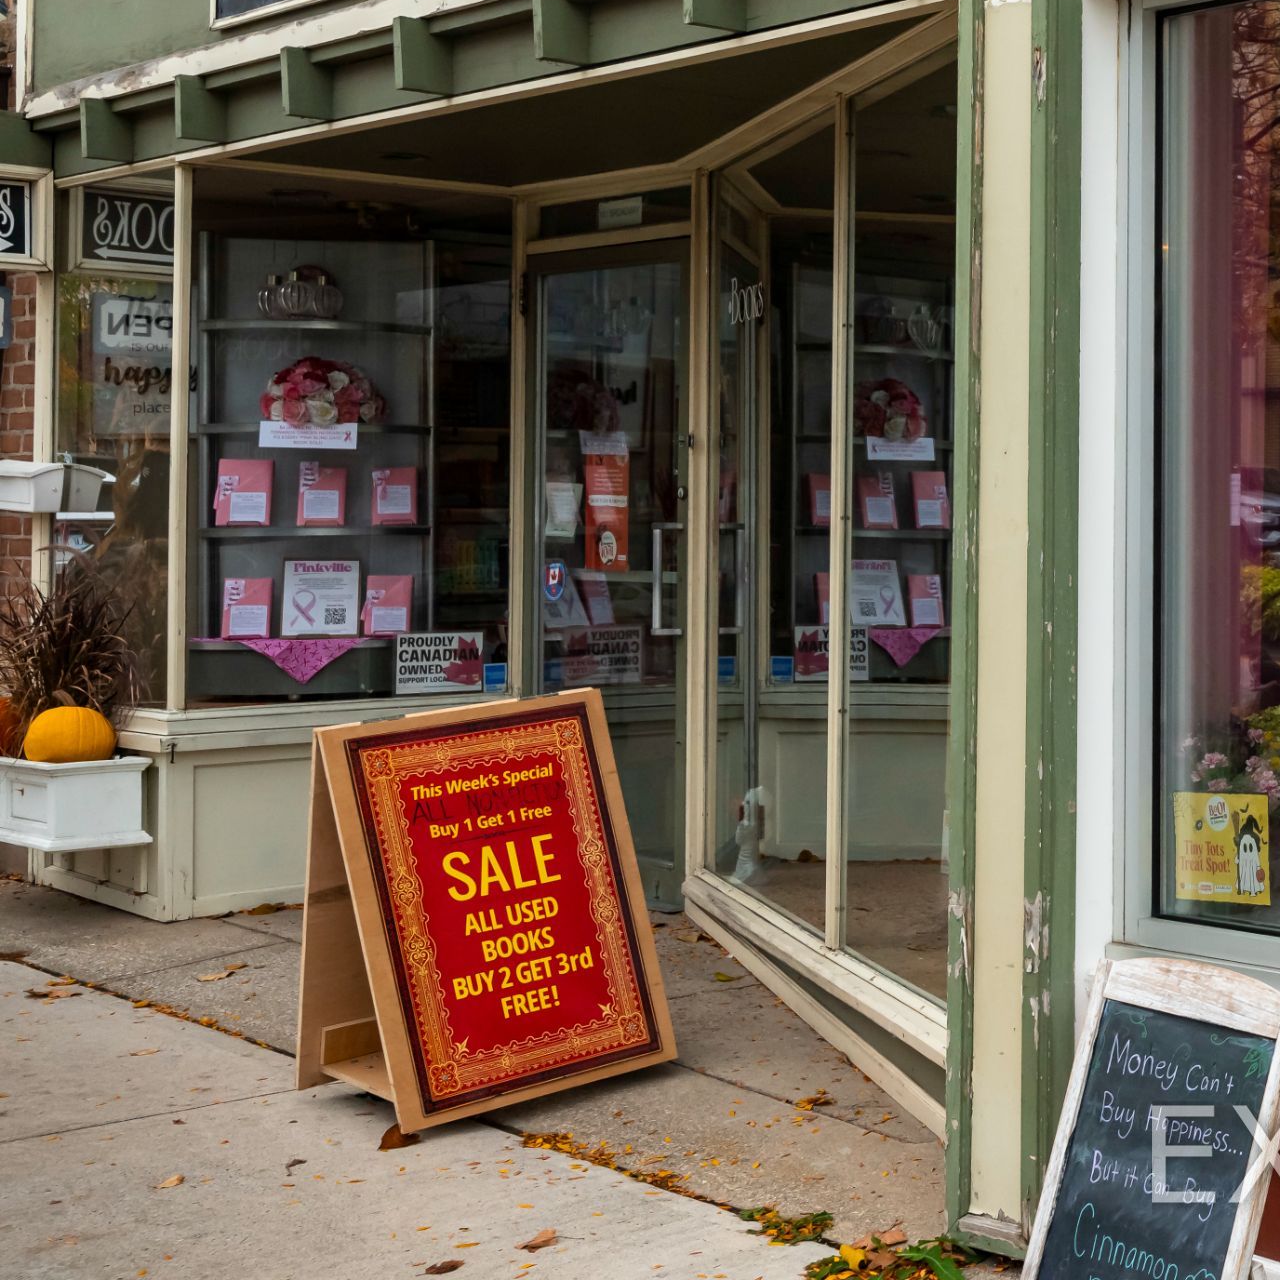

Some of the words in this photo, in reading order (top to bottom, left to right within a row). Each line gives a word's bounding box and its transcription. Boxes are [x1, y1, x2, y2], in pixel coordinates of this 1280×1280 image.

[399, 648, 480, 662] CANADIAN
[400, 636, 454, 647] PROUDLY
[399, 665, 443, 675] OWNED
[411, 783, 442, 801] This
[502, 763, 553, 786] Special
[429, 823, 460, 838] Buy
[464, 818, 473, 832] 1
[477, 814, 504, 829] Get
[507, 810, 516, 822] 1
[520, 805, 552, 821] Free
[1205, 841, 1224, 856] Tots
[1206, 858, 1230, 876] Spot!
[442, 833, 562, 902] SALE
[464, 909, 502, 937] ALL
[508, 896, 559, 928] USED
[481, 926, 555, 963] BOOKS
[452, 973, 497, 1001] BUY
[499, 966, 513, 990] 2
[515, 955, 555, 986] GET
[558, 946, 594, 977] 3rd
[500, 985, 560, 1019] FREE!
[1106, 1032, 1179, 1090] Money
[1185, 1064, 1234, 1095] Can't
[1099, 1090, 1136, 1139] Buy
[1089, 1149, 1119, 1184] But
[1124, 1165, 1138, 1188] it
[1143, 1173, 1169, 1196] Can
[1182, 1177, 1216, 1222] Buy
[1074, 1202, 1179, 1280] Cinnamon
